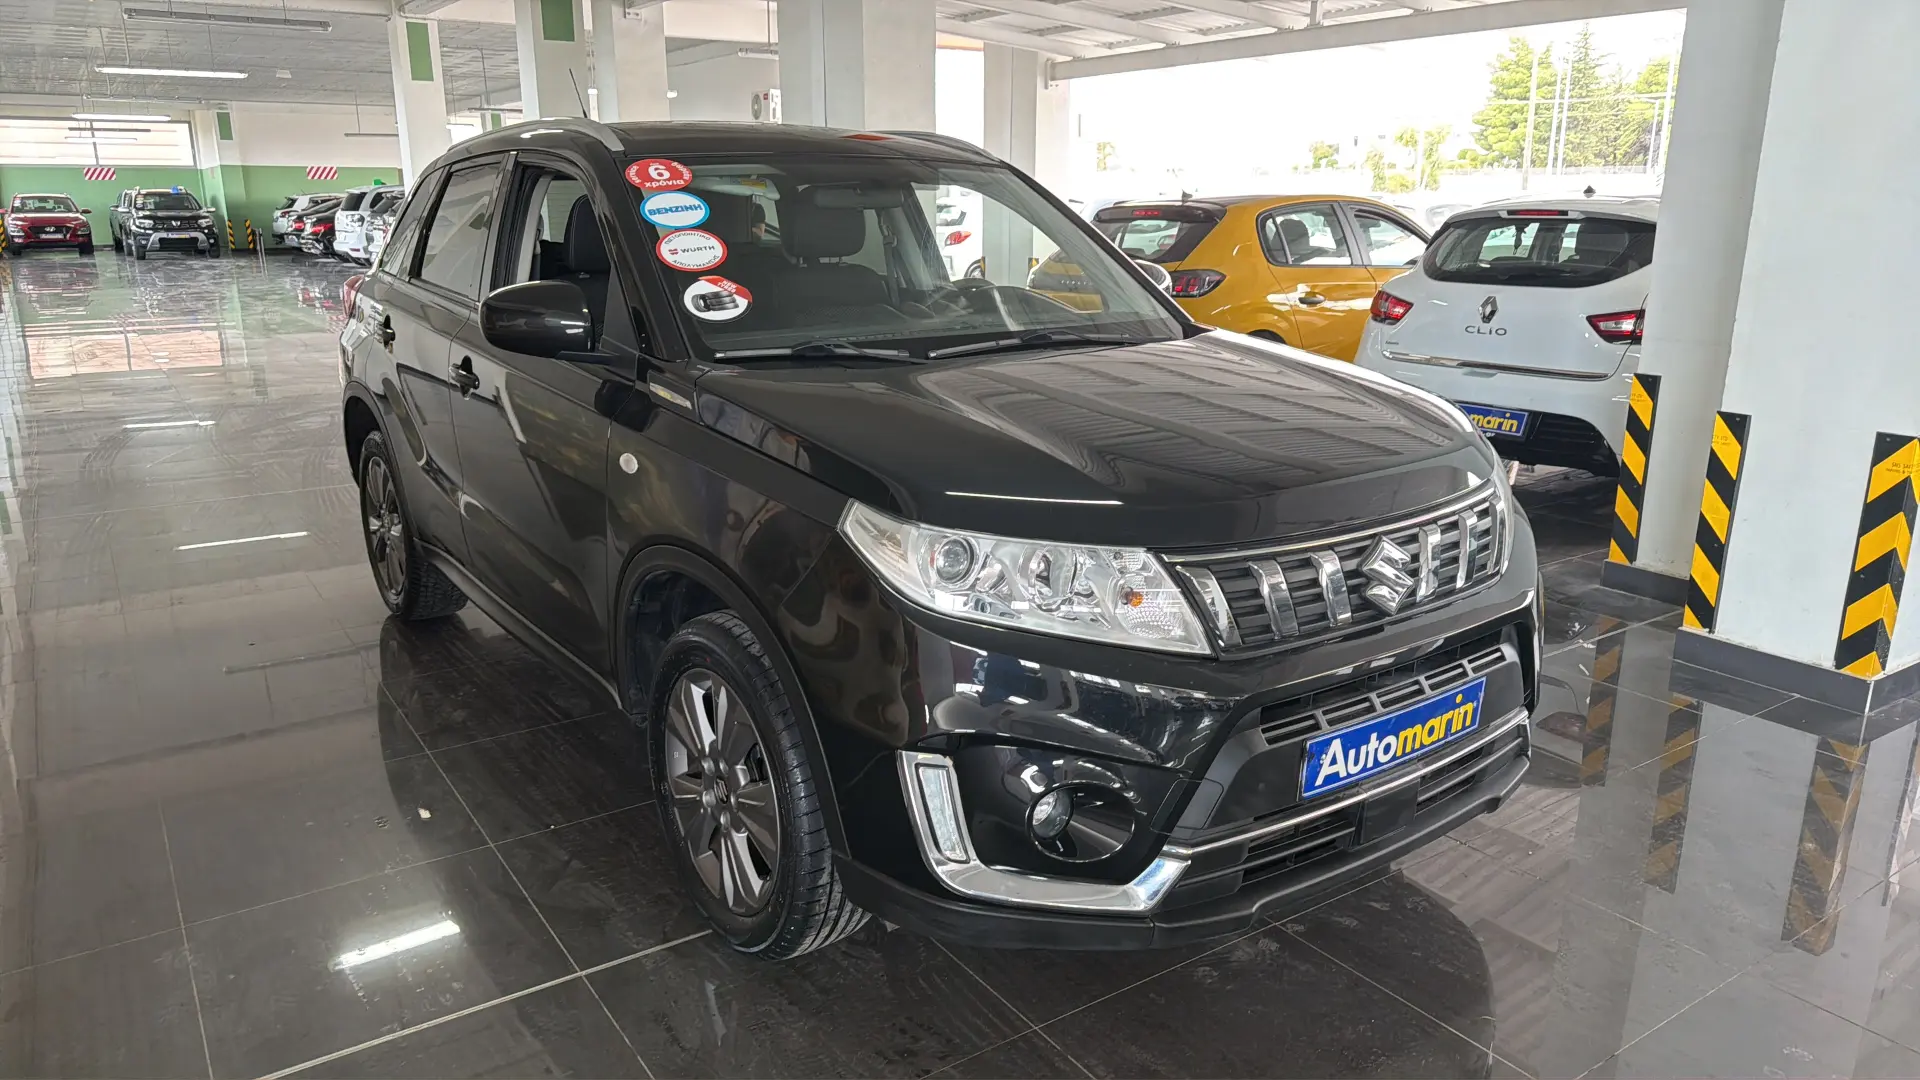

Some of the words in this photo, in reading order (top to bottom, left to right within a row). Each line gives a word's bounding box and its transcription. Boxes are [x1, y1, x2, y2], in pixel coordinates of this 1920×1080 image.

[648, 164, 670, 180] 6
[644, 179, 685, 188] χρόνια
[1464, 325, 1508, 336] CLIO
[1470, 412, 1519, 433] marin
[1314, 693, 1474, 787] Automarin
